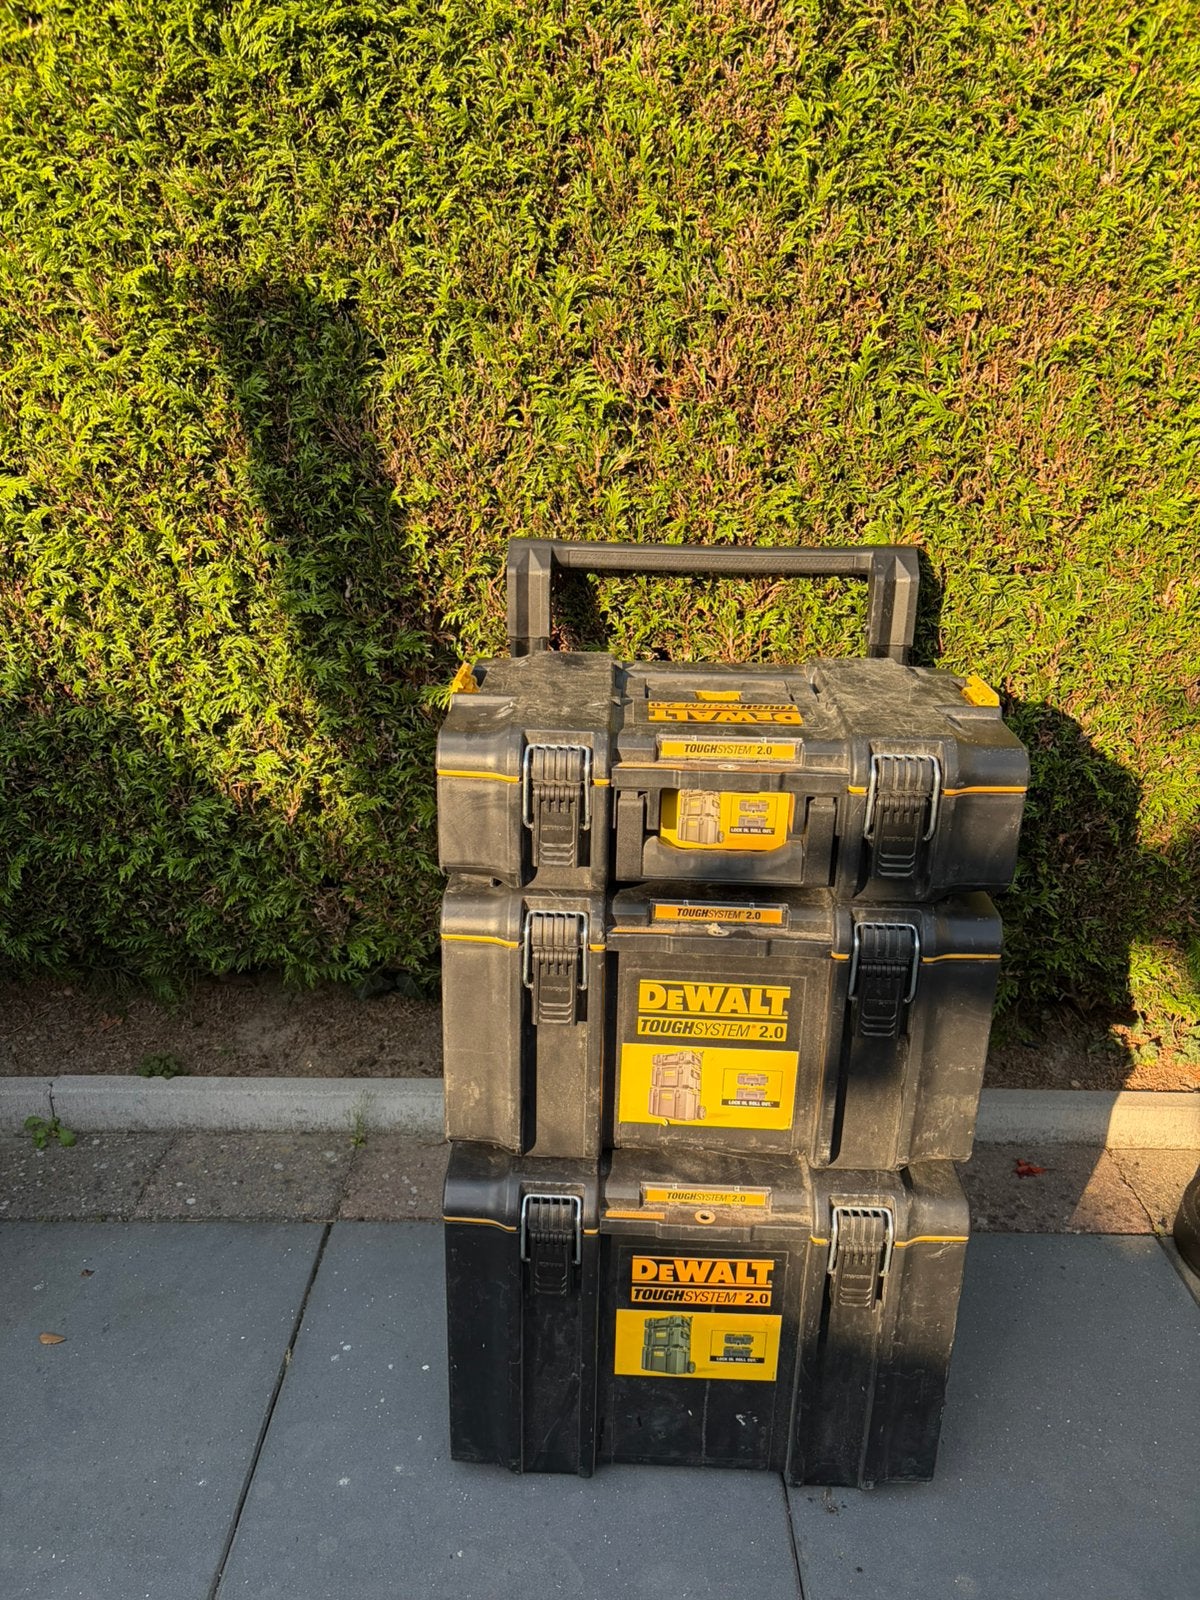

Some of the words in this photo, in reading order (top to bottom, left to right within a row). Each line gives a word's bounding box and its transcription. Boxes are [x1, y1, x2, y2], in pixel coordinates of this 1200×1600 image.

[757, 746, 773, 755] 2.0
[746, 911, 761, 920] 2.0
[759, 1025, 784, 1039] 2.0
[732, 1195, 746, 1203] 2.0
[745, 1293, 769, 1304] 2.0
